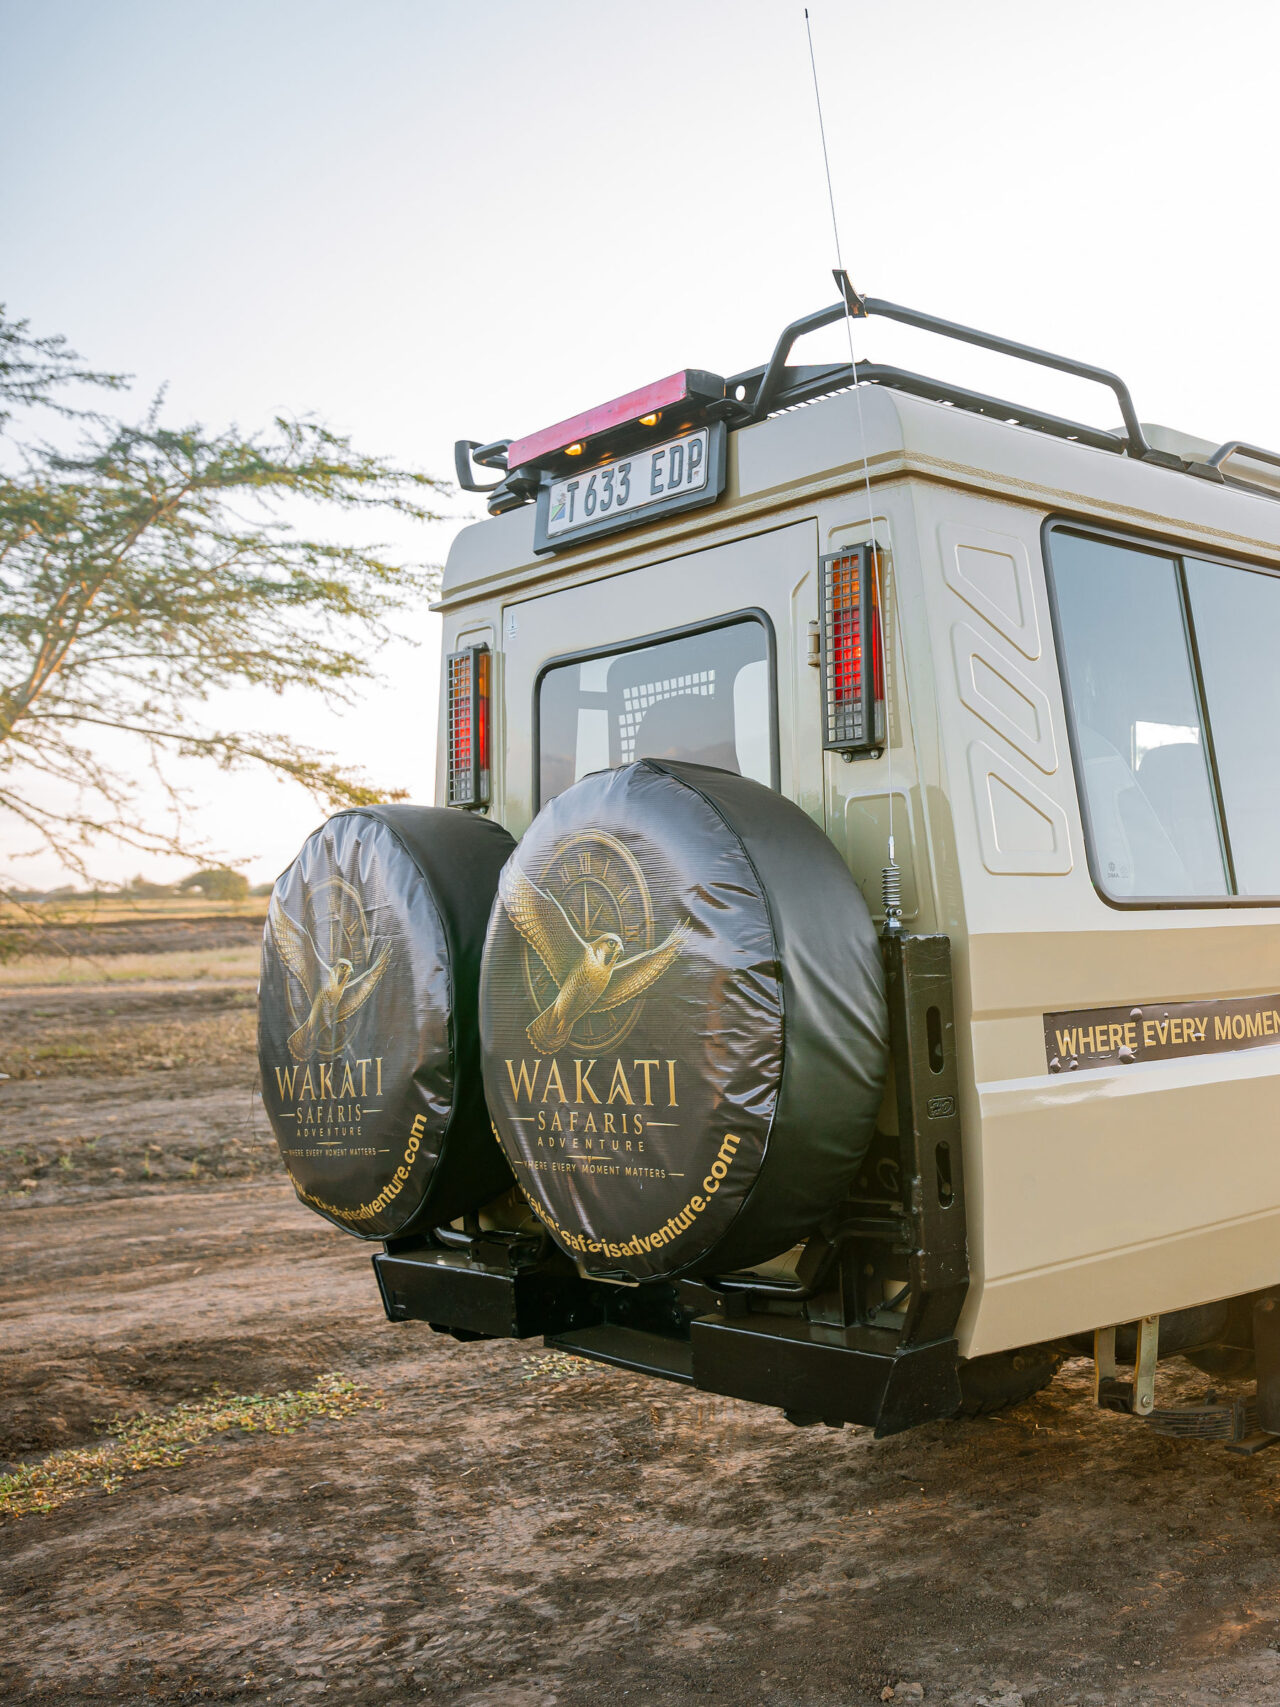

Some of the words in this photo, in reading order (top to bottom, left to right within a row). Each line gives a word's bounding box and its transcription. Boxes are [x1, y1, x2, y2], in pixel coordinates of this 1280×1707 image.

[650, 438, 703, 496] EDP
[1055, 1022, 1138, 1057] WHERE
[1142, 1016, 1208, 1047] EVERY
[274, 1057, 384, 1102] WAKATI
[504, 1057, 680, 1107] WAKATI
[296, 1103, 362, 1124] SAFARIS
[537, 1110, 643, 1135] SAFARIS
[296, 1126, 362, 1137] ADVENTURE
[349, 1147, 377, 1156] MATTERS
[537, 1136, 645, 1152] ADVENTURE
[552, 1162, 577, 1173] EVERY
[581, 1164, 620, 1176] MOMENT
[625, 1167, 666, 1179] MATTERS
